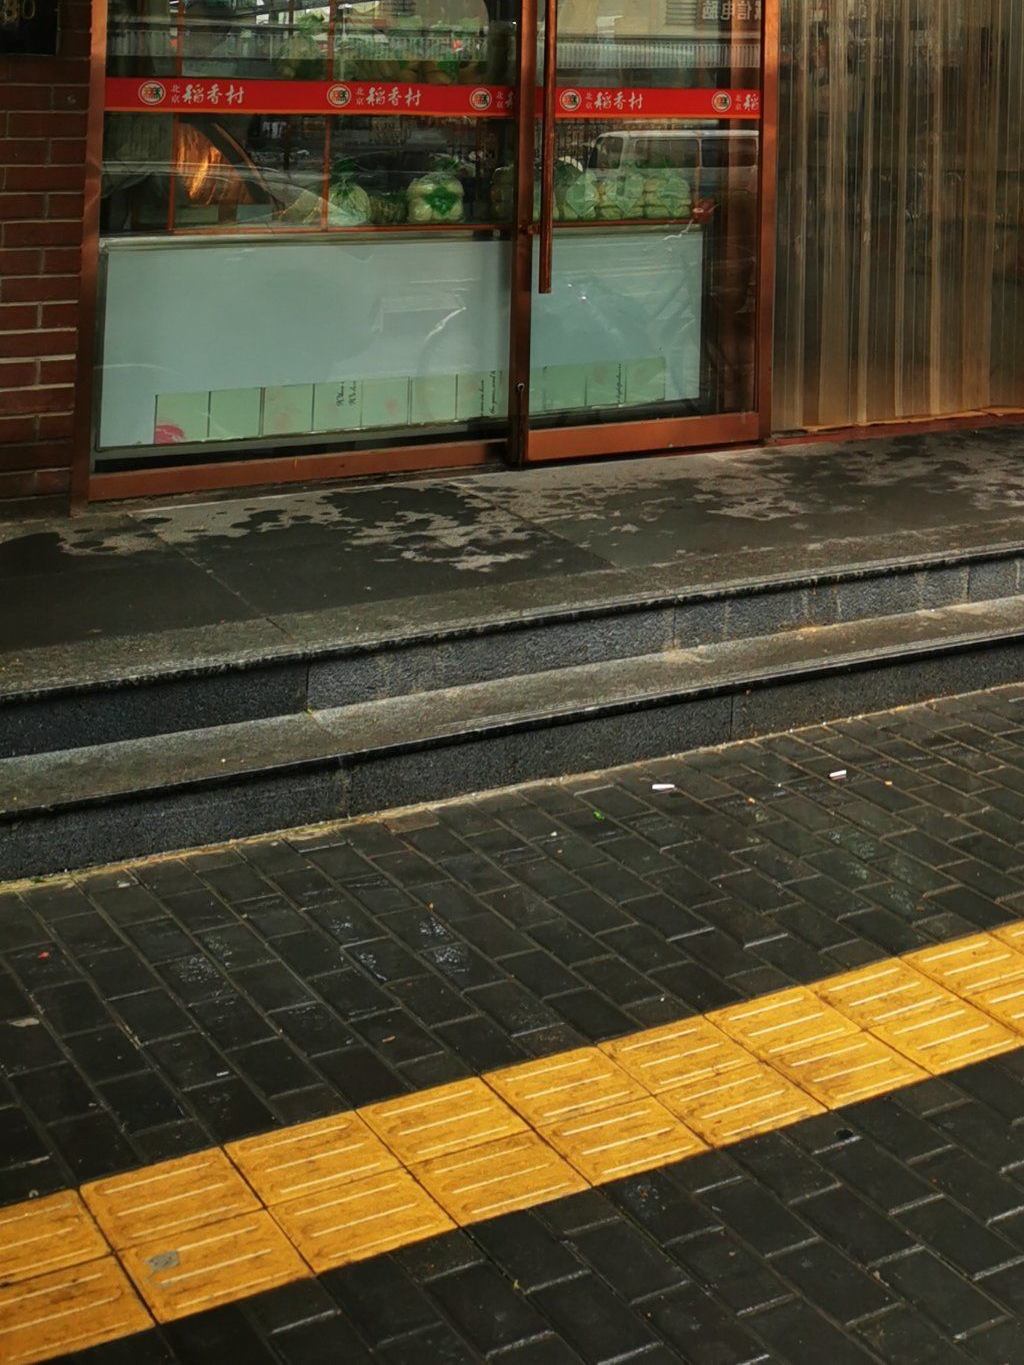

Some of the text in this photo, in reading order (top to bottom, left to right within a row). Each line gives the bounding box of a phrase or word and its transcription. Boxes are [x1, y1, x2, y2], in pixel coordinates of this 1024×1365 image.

[182, 83, 244, 106] 稻香村
[366, 86, 422, 107] 稻香村
[594, 90, 644, 111] 稻香村
